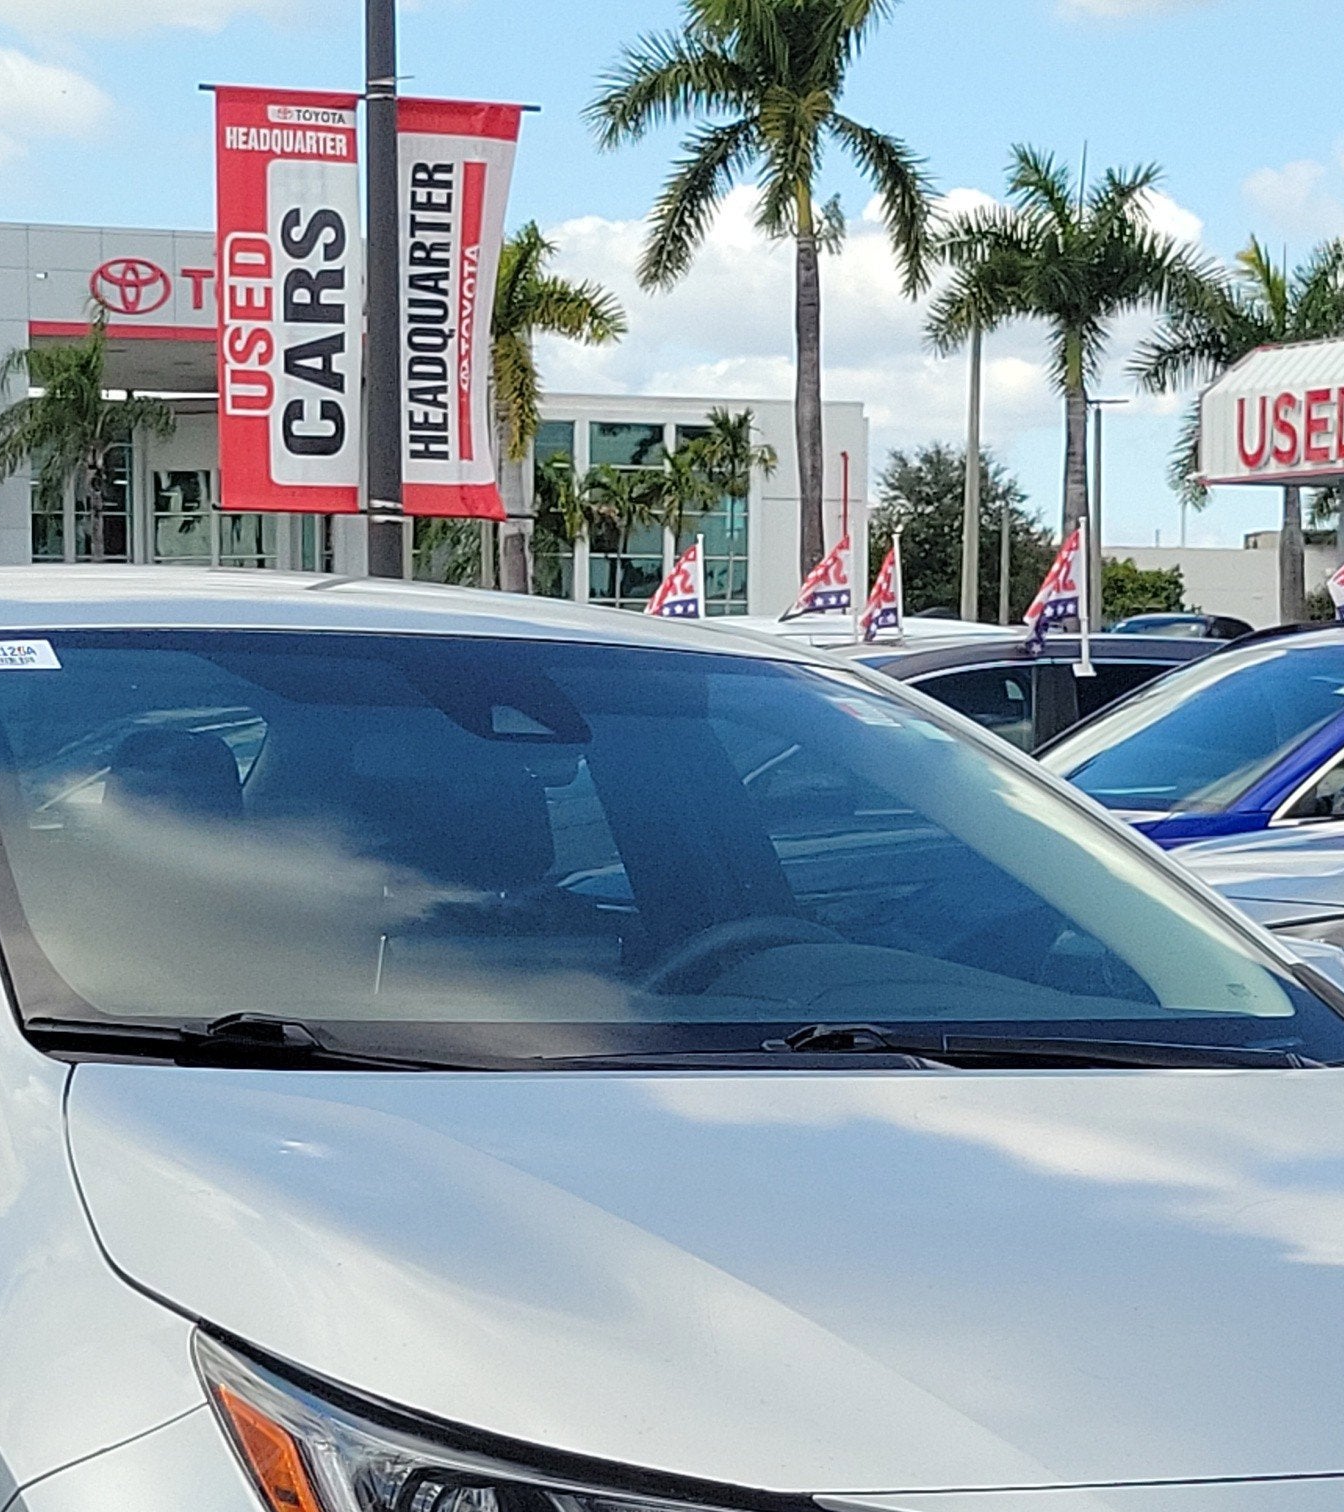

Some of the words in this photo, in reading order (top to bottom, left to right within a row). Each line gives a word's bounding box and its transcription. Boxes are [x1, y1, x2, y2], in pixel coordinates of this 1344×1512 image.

[225, 126, 348, 157] HEADQUARTER
[296, 109, 346, 125] TOYOTA
[225, 232, 275, 416] USED
[281, 207, 347, 457] CARS
[407, 162, 455, 461] HEADQUARTER
